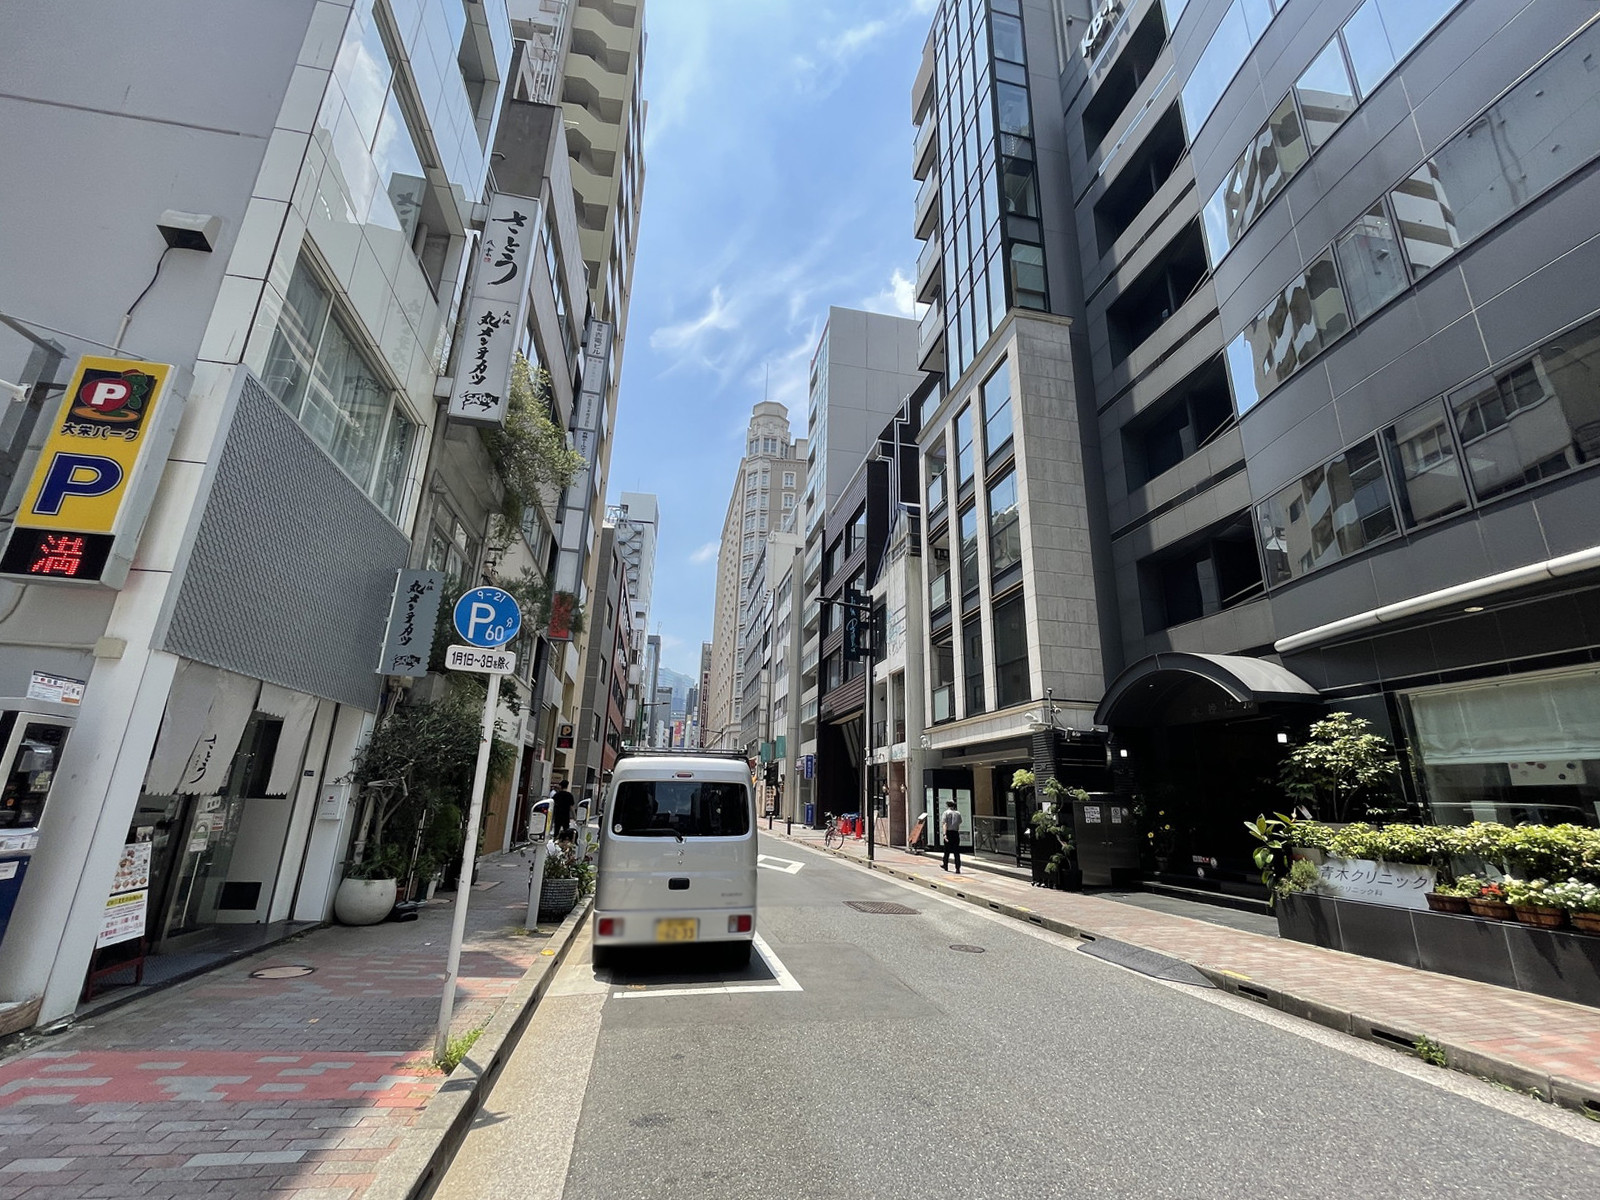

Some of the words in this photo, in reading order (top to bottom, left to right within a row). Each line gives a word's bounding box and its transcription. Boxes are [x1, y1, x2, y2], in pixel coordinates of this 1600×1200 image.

[487, 210, 528, 285] さとう
[61, 421, 140, 442] 大栄パーク
[31, 451, 124, 516] P
[31, 534, 83, 576] 満
[477, 590, 507, 604] 9-21
[467, 601, 496, 639] P
[1320, 865, 1429, 890] 青木クリニック
